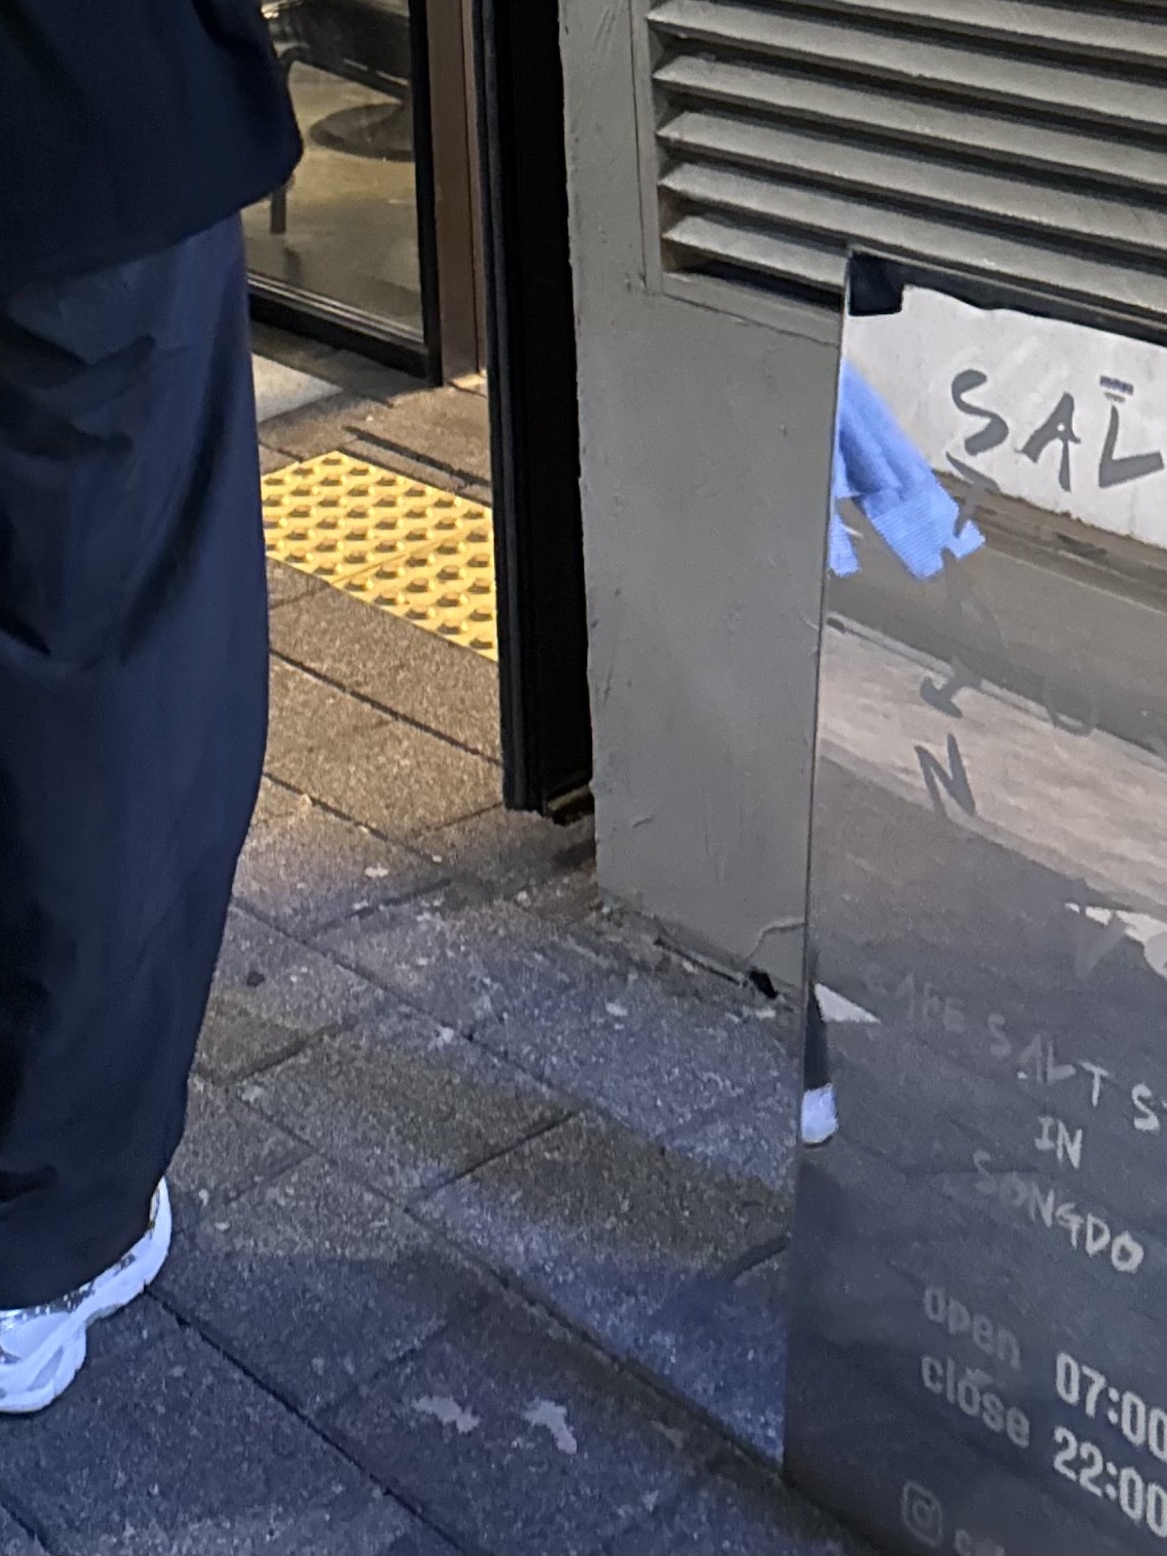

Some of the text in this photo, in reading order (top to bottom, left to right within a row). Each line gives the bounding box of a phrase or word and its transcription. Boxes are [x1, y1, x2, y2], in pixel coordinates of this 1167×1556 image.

[987, 1012, 1111, 1108] SALT
[1033, 1114, 1082, 1170] IN
[972, 1149, 1145, 1274] SONGDO
[924, 1285, 1167, 1463] open 07:00
[921, 1354, 1167, 1538] close 22:00
